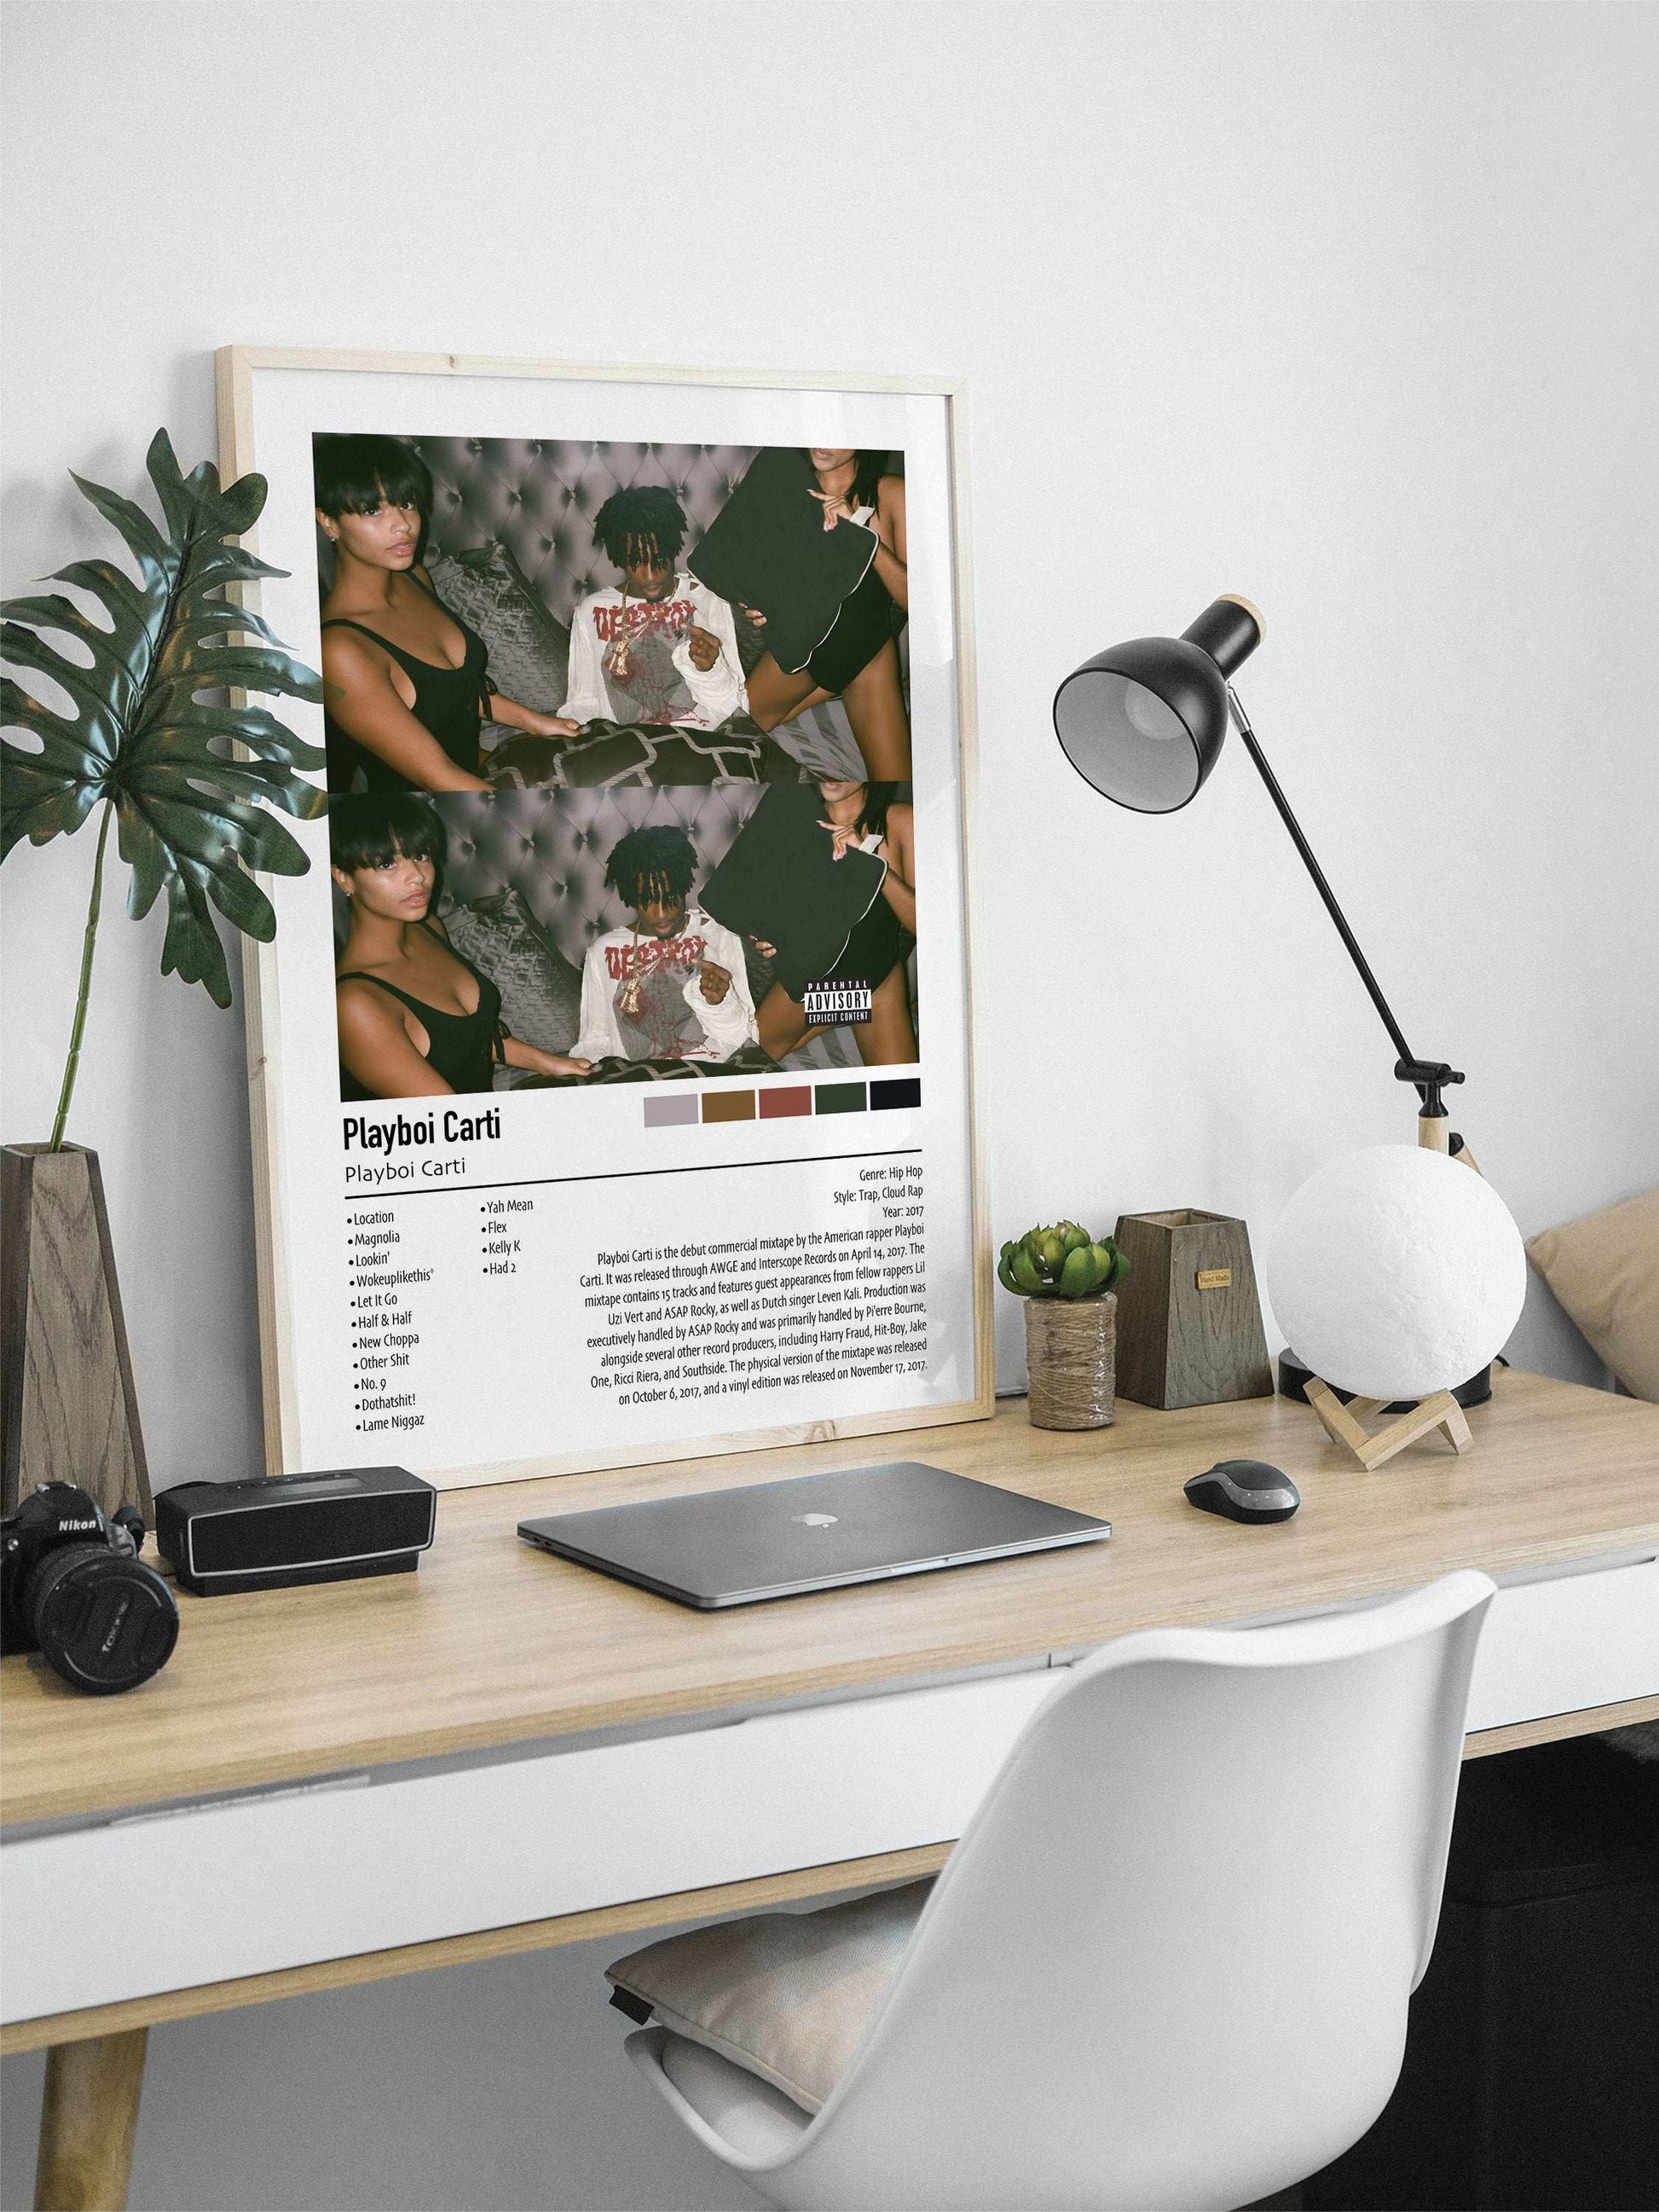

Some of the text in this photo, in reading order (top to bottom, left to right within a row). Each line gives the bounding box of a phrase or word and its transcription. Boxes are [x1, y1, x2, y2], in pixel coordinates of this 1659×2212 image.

[808, 980, 868, 992] PARENTAL
[807, 991, 869, 1011] ADVISORY
[808, 1011, 868, 1023] EXPLICIT CONTENT
[343, 1107, 500, 1156] Playboi Carti
[344, 1156, 465, 1185] Playboi Carti
[858, 1165, 923, 1182] Genre: Hip Hop
[833, 1184, 923, 1206] Style: Trap, Cloud Rap
[486, 1199, 534, 1214] Yah Mean
[882, 1205, 924, 1218] Year: 2017
[353, 1210, 394, 1225] Location
[488, 1219, 507, 1234] Flex
[354, 1229, 400, 1248] Magnolia
[488, 1239, 521, 1256] Kelly K
[597, 1221, 924, 1267] Playboi Carti is the debut commercial mixtape by the American rapper Playboi
[355, 1250, 390, 1267] Lookin'
[489, 1259, 517, 1275] Had 2
[579, 1241, 925, 1288] Carti. It was released through AWGE and Interscope Records on April 14, 2017. The
[584, 1259, 925, 1309] mixtape contains 15 tracks and features guest appearances from fellow rappers Lil
[357, 1292, 397, 1308] Let It Go
[607, 1282, 927, 1326] Uzi Vert and ASAP Rocky, as well as Dutch singer Leven Kali. Production was
[358, 1310, 413, 1329] Half & Half
[587, 1301, 927, 1348] executively handled by ASAP Rocky and was primarily handled by Pi'erre Bourne,
[359, 1332, 419, 1350] New Choppa
[600, 1318, 928, 1369] alongside several other record producers, including Harry Fraud, Hit-Boy, Jake
[359, 1352, 410, 1370] Other Shit
[590, 1336, 928, 1388] One, Ricci Riera, and Southside. The physical version of the mixtape was released
[361, 1377, 387, 1392] No. 9
[618, 1359, 928, 1405] on October 6, 2017, and a vinyl edition was released on November 17, 2017.
[361, 1393, 416, 1411] Dothatshit!
[362, 1414, 425, 1432] Lame Niggaz
[58, 1520, 96, 1532] Nikon
